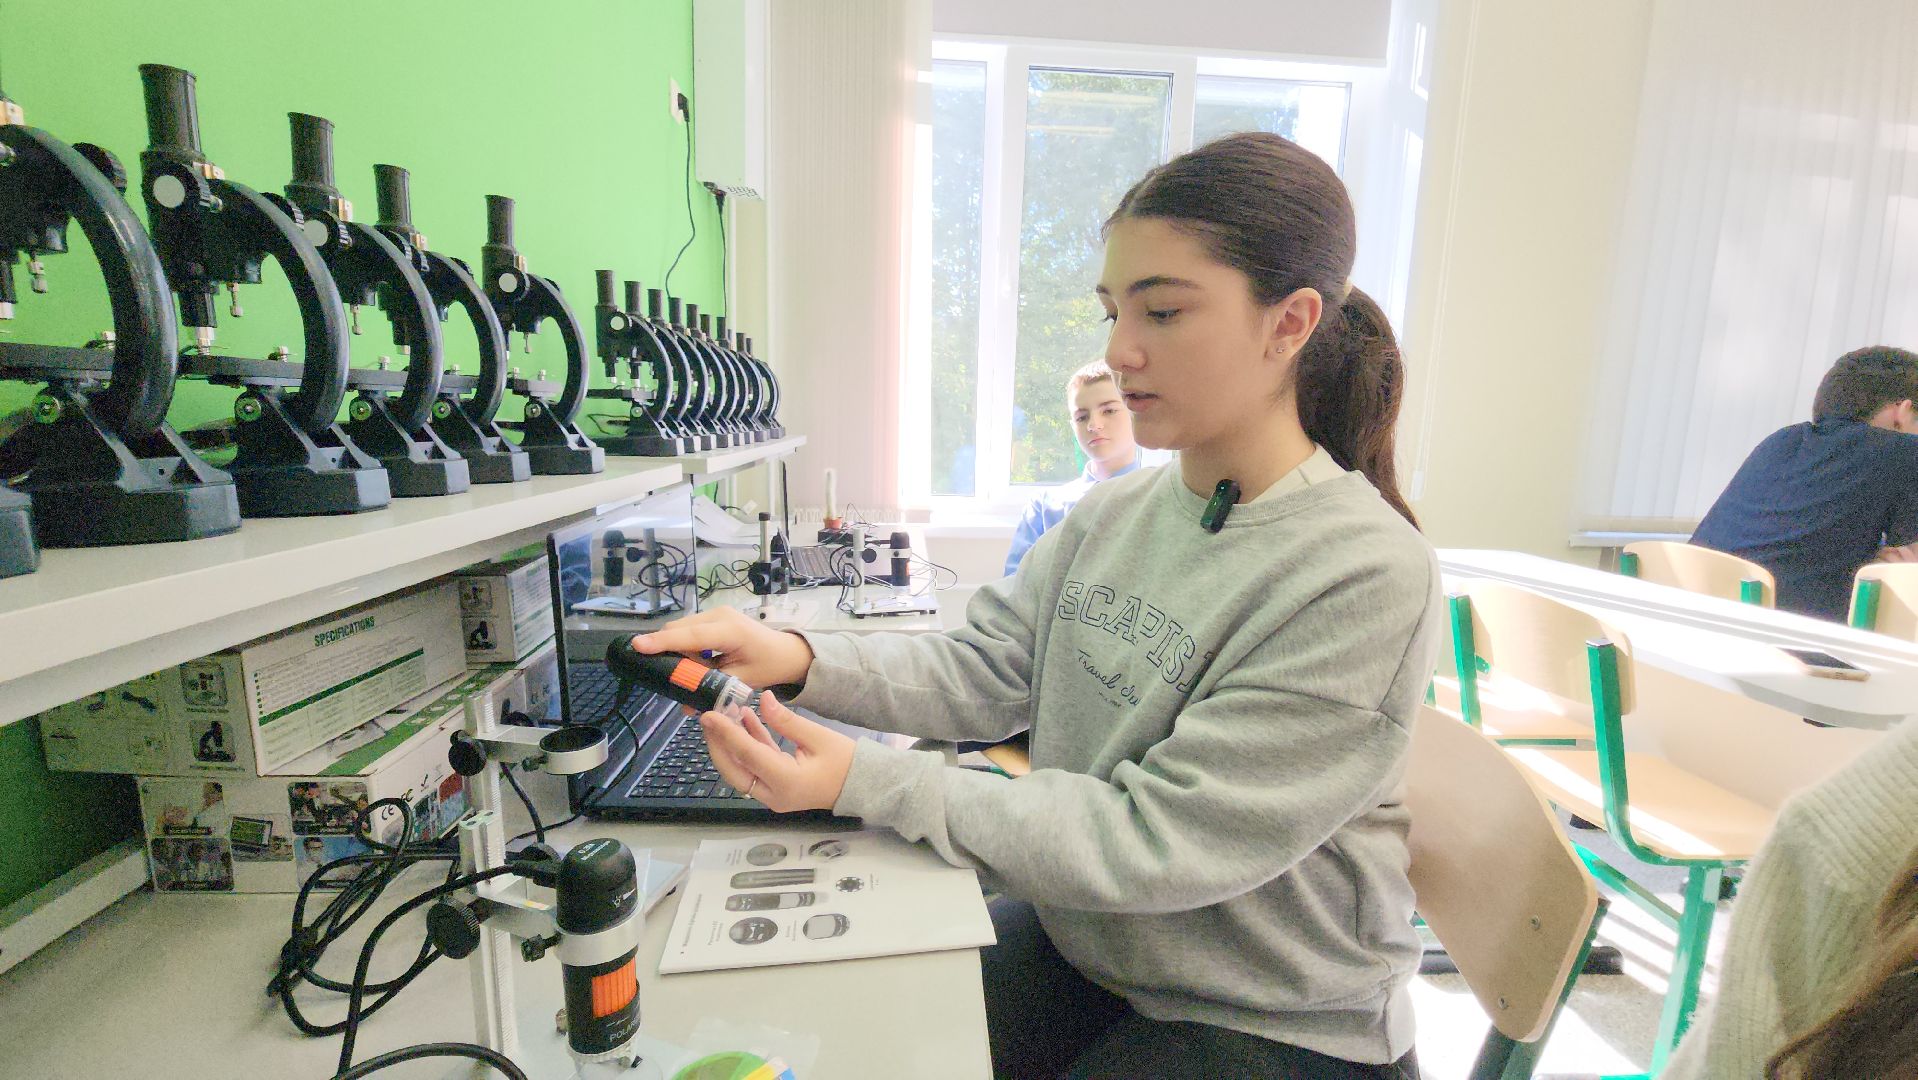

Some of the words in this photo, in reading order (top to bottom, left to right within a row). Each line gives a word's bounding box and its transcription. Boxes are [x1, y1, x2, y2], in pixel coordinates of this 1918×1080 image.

[314, 616, 375, 647] SPECIFICATIONS
[1077, 649, 1121, 689] Travel
[381, 803, 395, 820] CE
